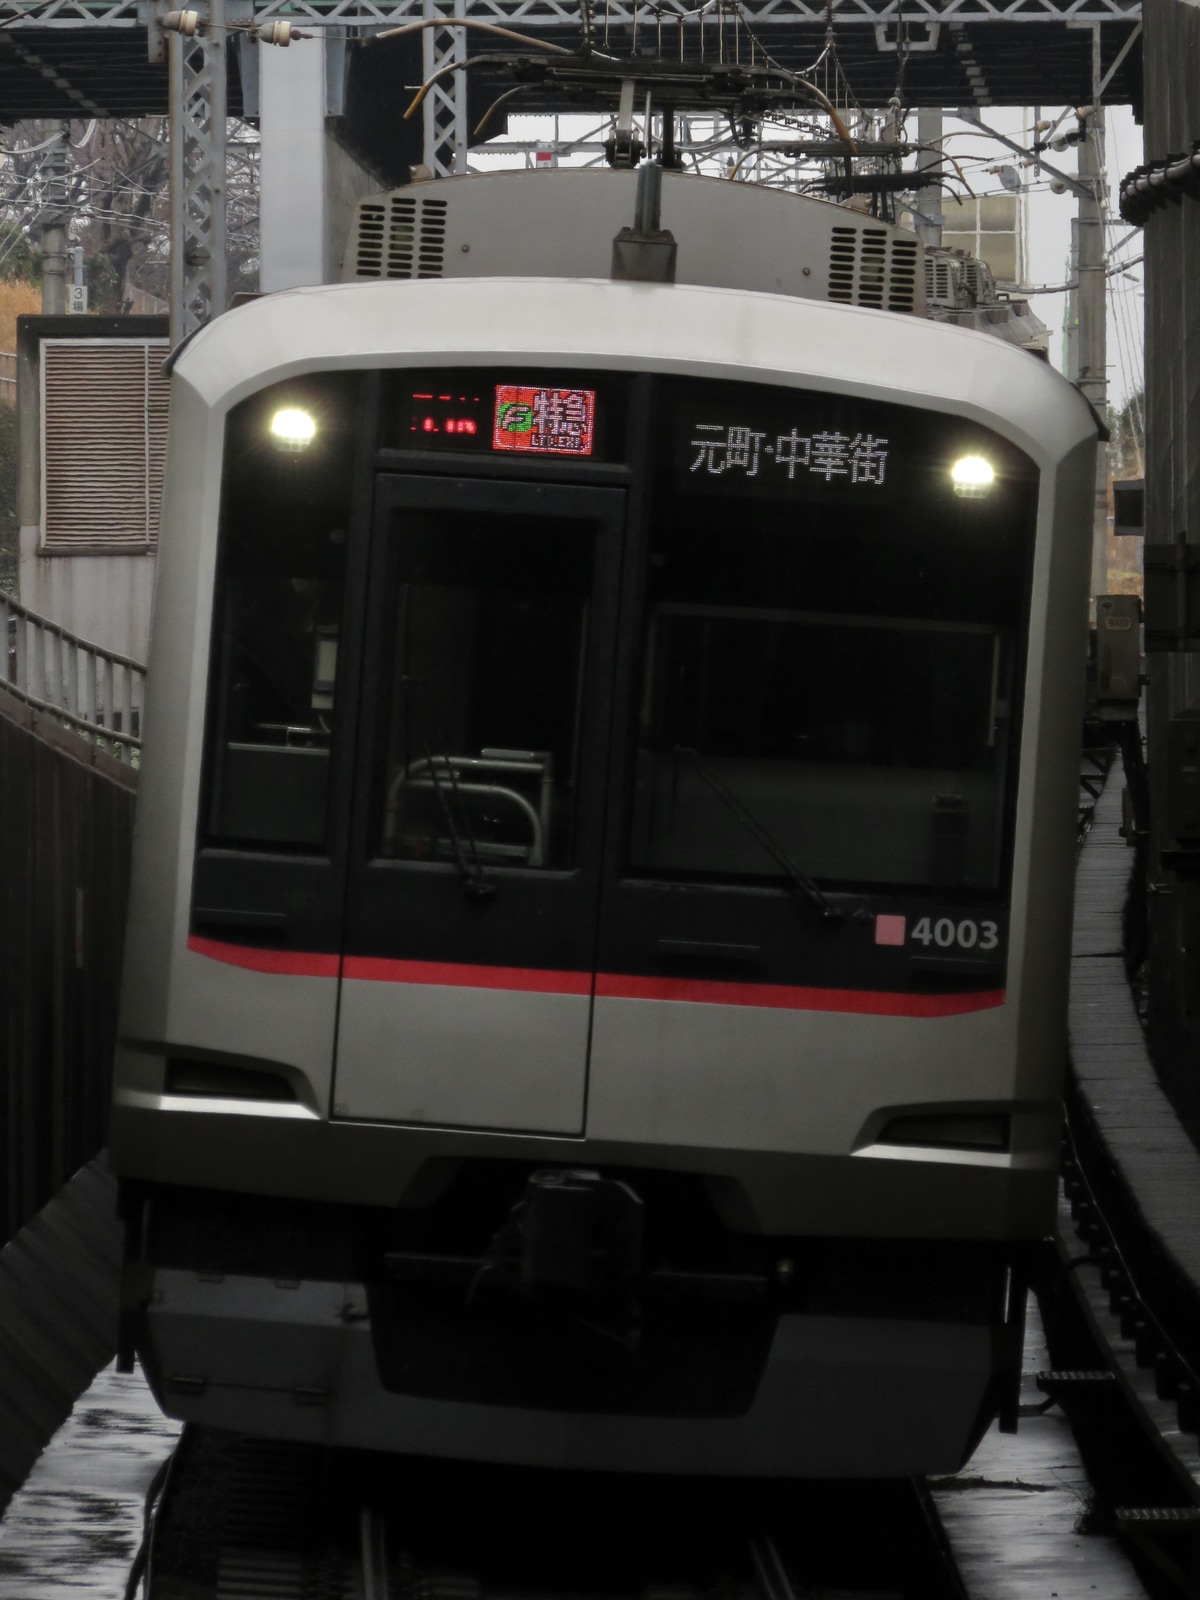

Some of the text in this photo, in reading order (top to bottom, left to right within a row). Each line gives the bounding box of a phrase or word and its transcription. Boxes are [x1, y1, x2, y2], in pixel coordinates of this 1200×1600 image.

[533, 391, 587, 435] 特急
[689, 424, 889, 485] 元町・中華街
[911, 917, 999, 949] 4003
